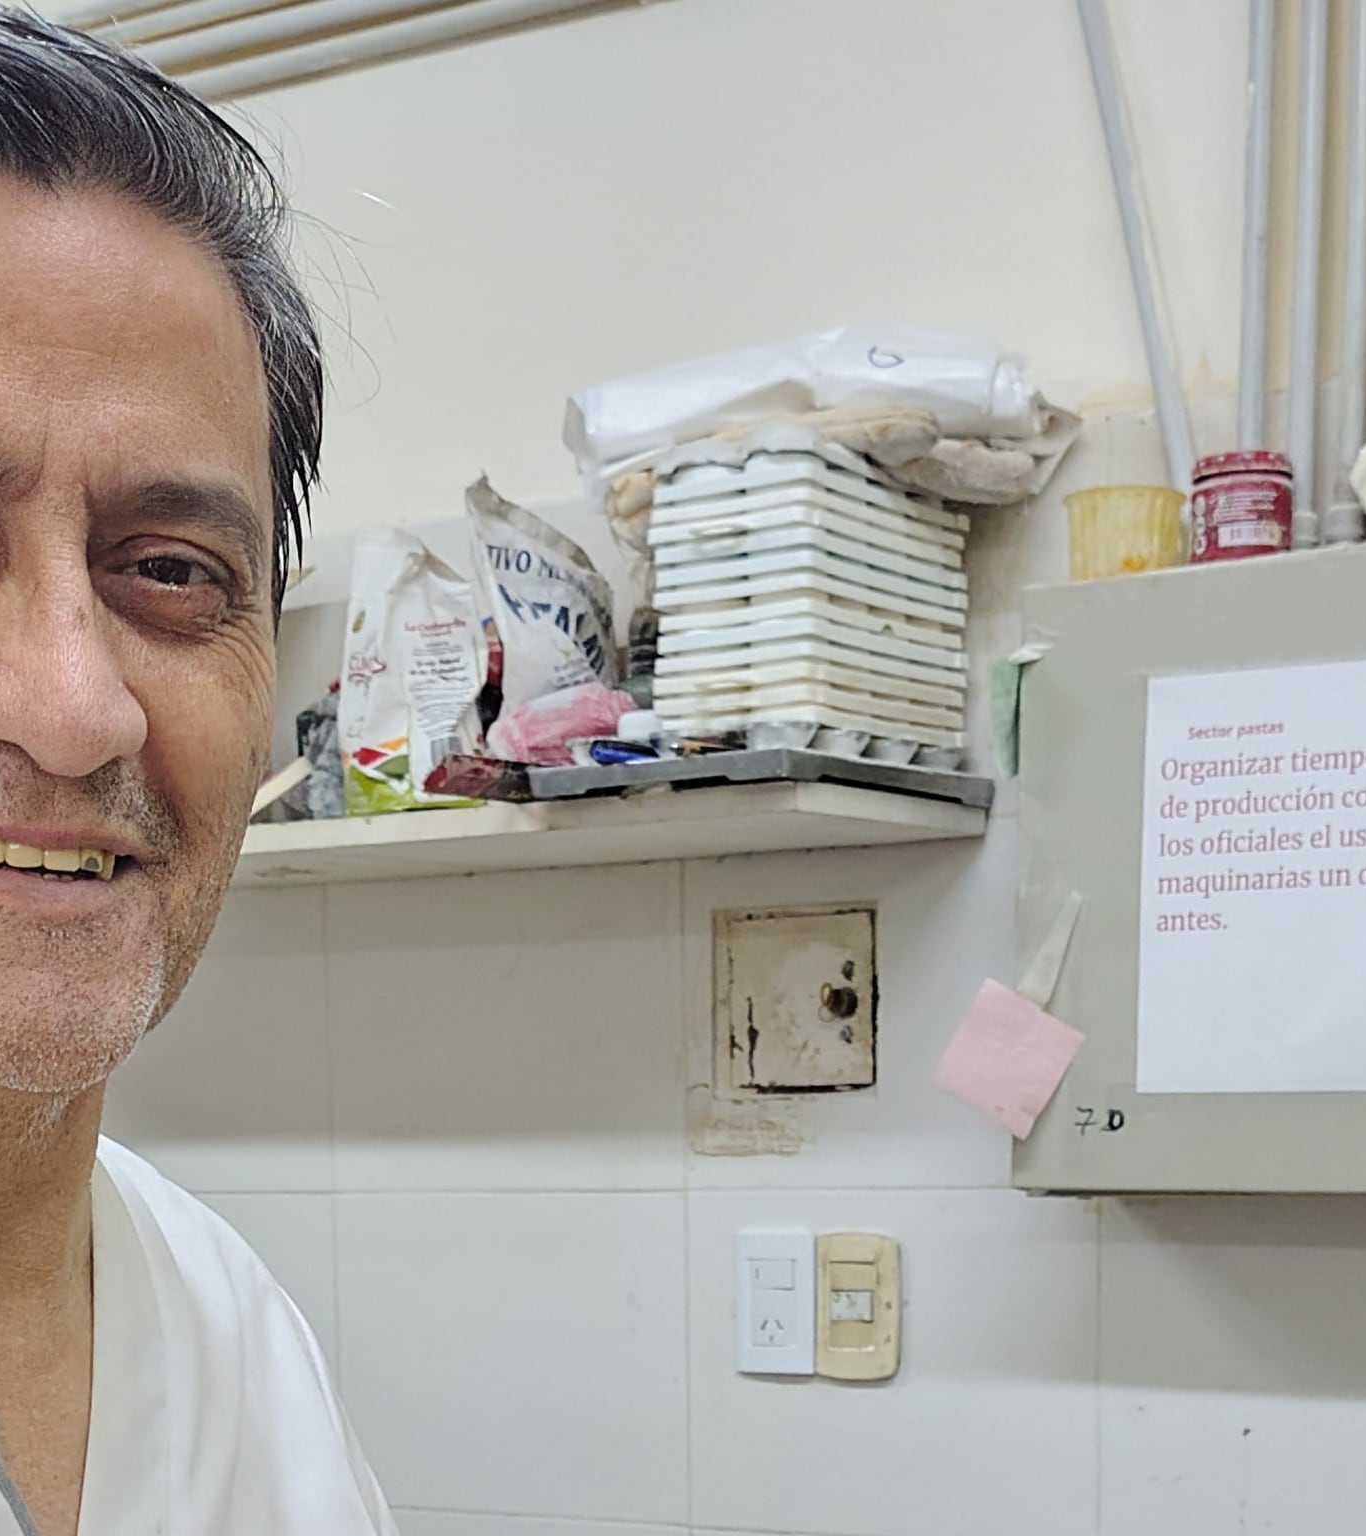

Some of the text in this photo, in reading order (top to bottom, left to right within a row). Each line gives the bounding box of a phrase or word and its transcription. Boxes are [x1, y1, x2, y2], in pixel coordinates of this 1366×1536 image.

[1188, 722, 1284, 740] Sector pastas
[1161, 753, 1284, 785] Organizar
[1160, 795, 1188, 818] de
[1195, 784, 1334, 823] producción
[1158, 832, 1193, 857] los
[1200, 827, 1303, 855] oficiales
[1310, 824, 1331, 849] el
[1157, 866, 1311, 899] maquinarias
[1318, 868, 1351, 888] un
[1156, 911, 1228, 932] antes.
